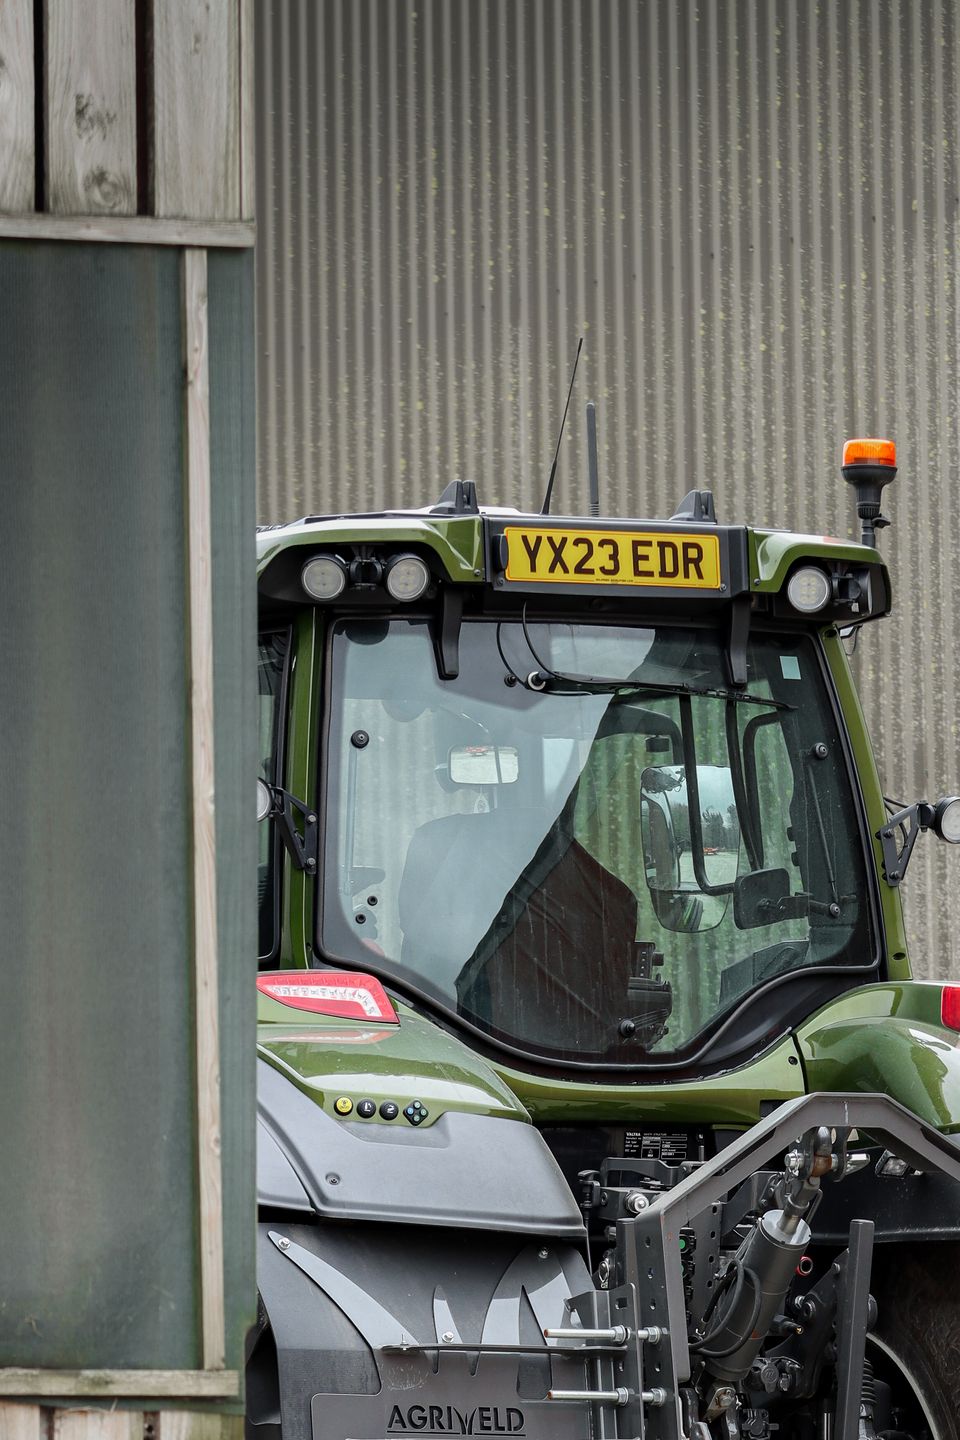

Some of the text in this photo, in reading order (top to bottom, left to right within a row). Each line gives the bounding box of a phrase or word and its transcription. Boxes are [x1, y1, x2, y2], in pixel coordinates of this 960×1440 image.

[521, 535, 704, 580] YX23 EDR
[387, 1405, 525, 1436] AGRIWELD
